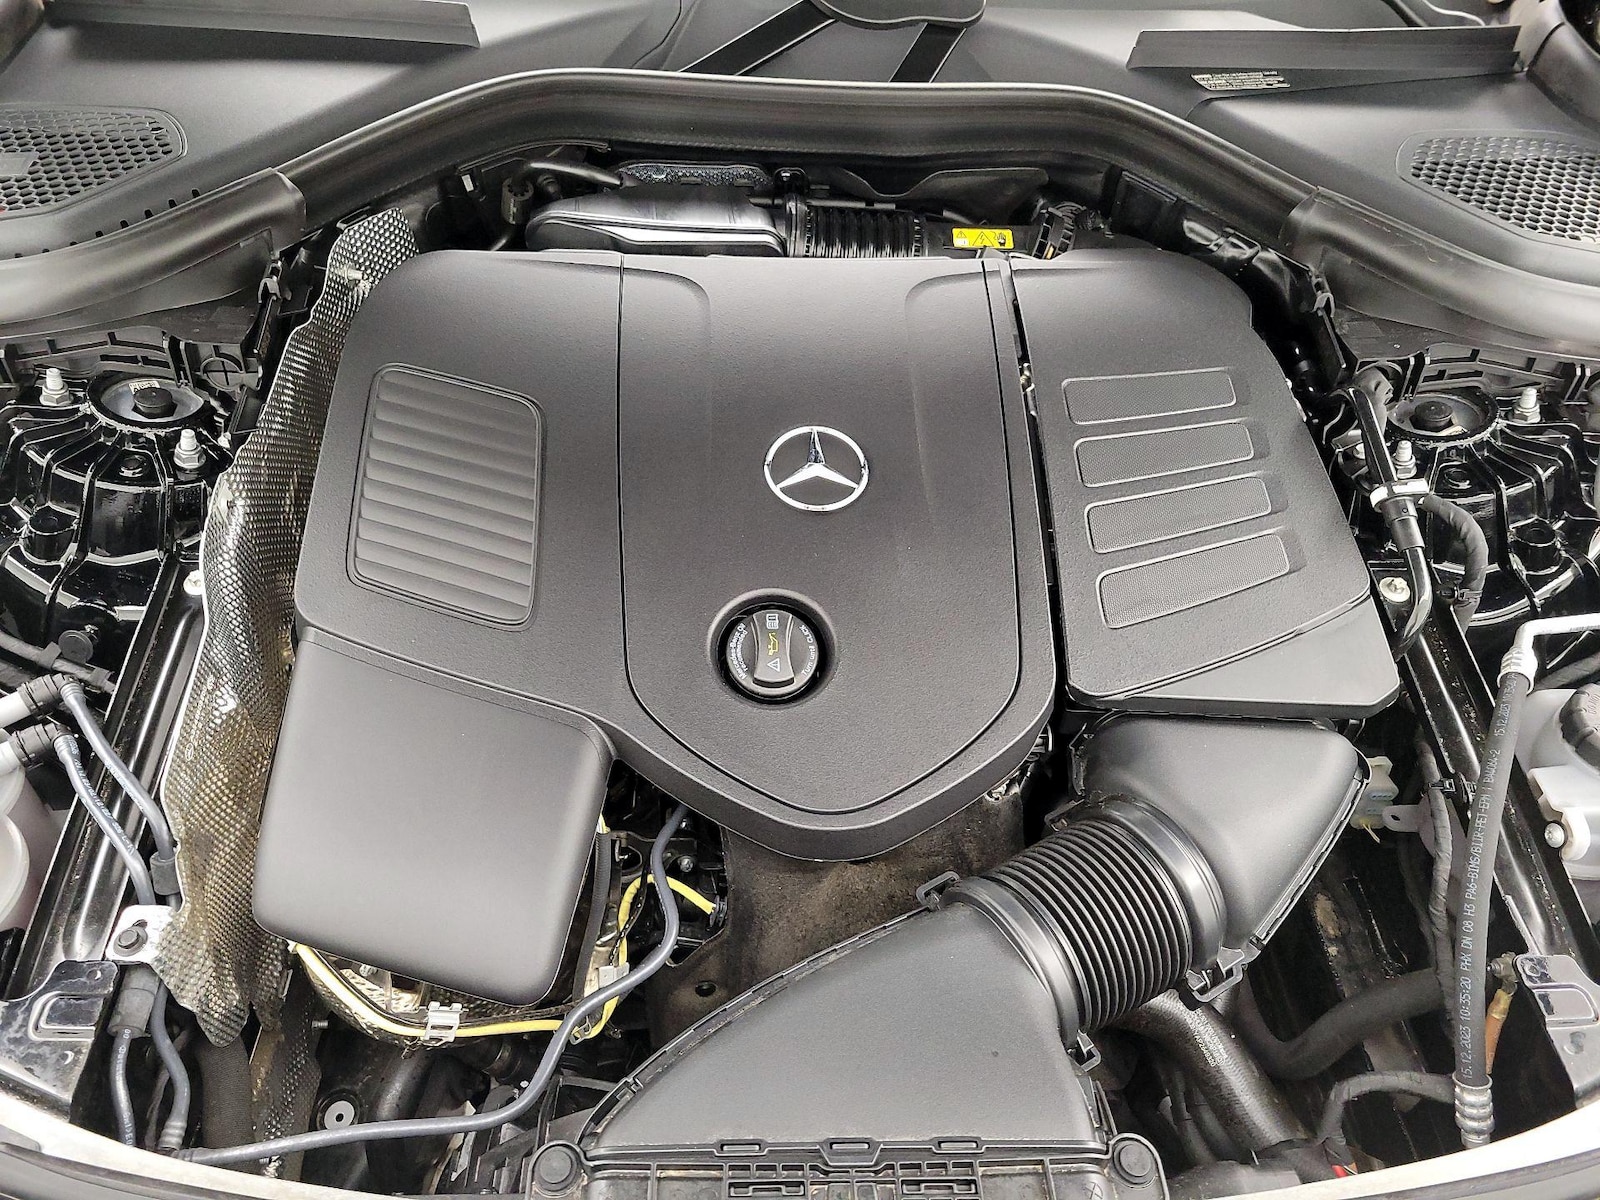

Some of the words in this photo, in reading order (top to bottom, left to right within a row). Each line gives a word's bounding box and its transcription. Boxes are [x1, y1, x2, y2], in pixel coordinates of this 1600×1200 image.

[799, 624, 814, 643] CLICK
[730, 631, 747, 680] Mercedes-Benz
[736, 630, 748, 671] recommended
[801, 662, 814, 676] Turn
[1462, 936, 1474, 948] DN
[1460, 952, 1472, 971] PHX
[1460, 976, 1472, 1020] 10:35:20
[1461, 1025, 1473, 1078] 15.12.2023
